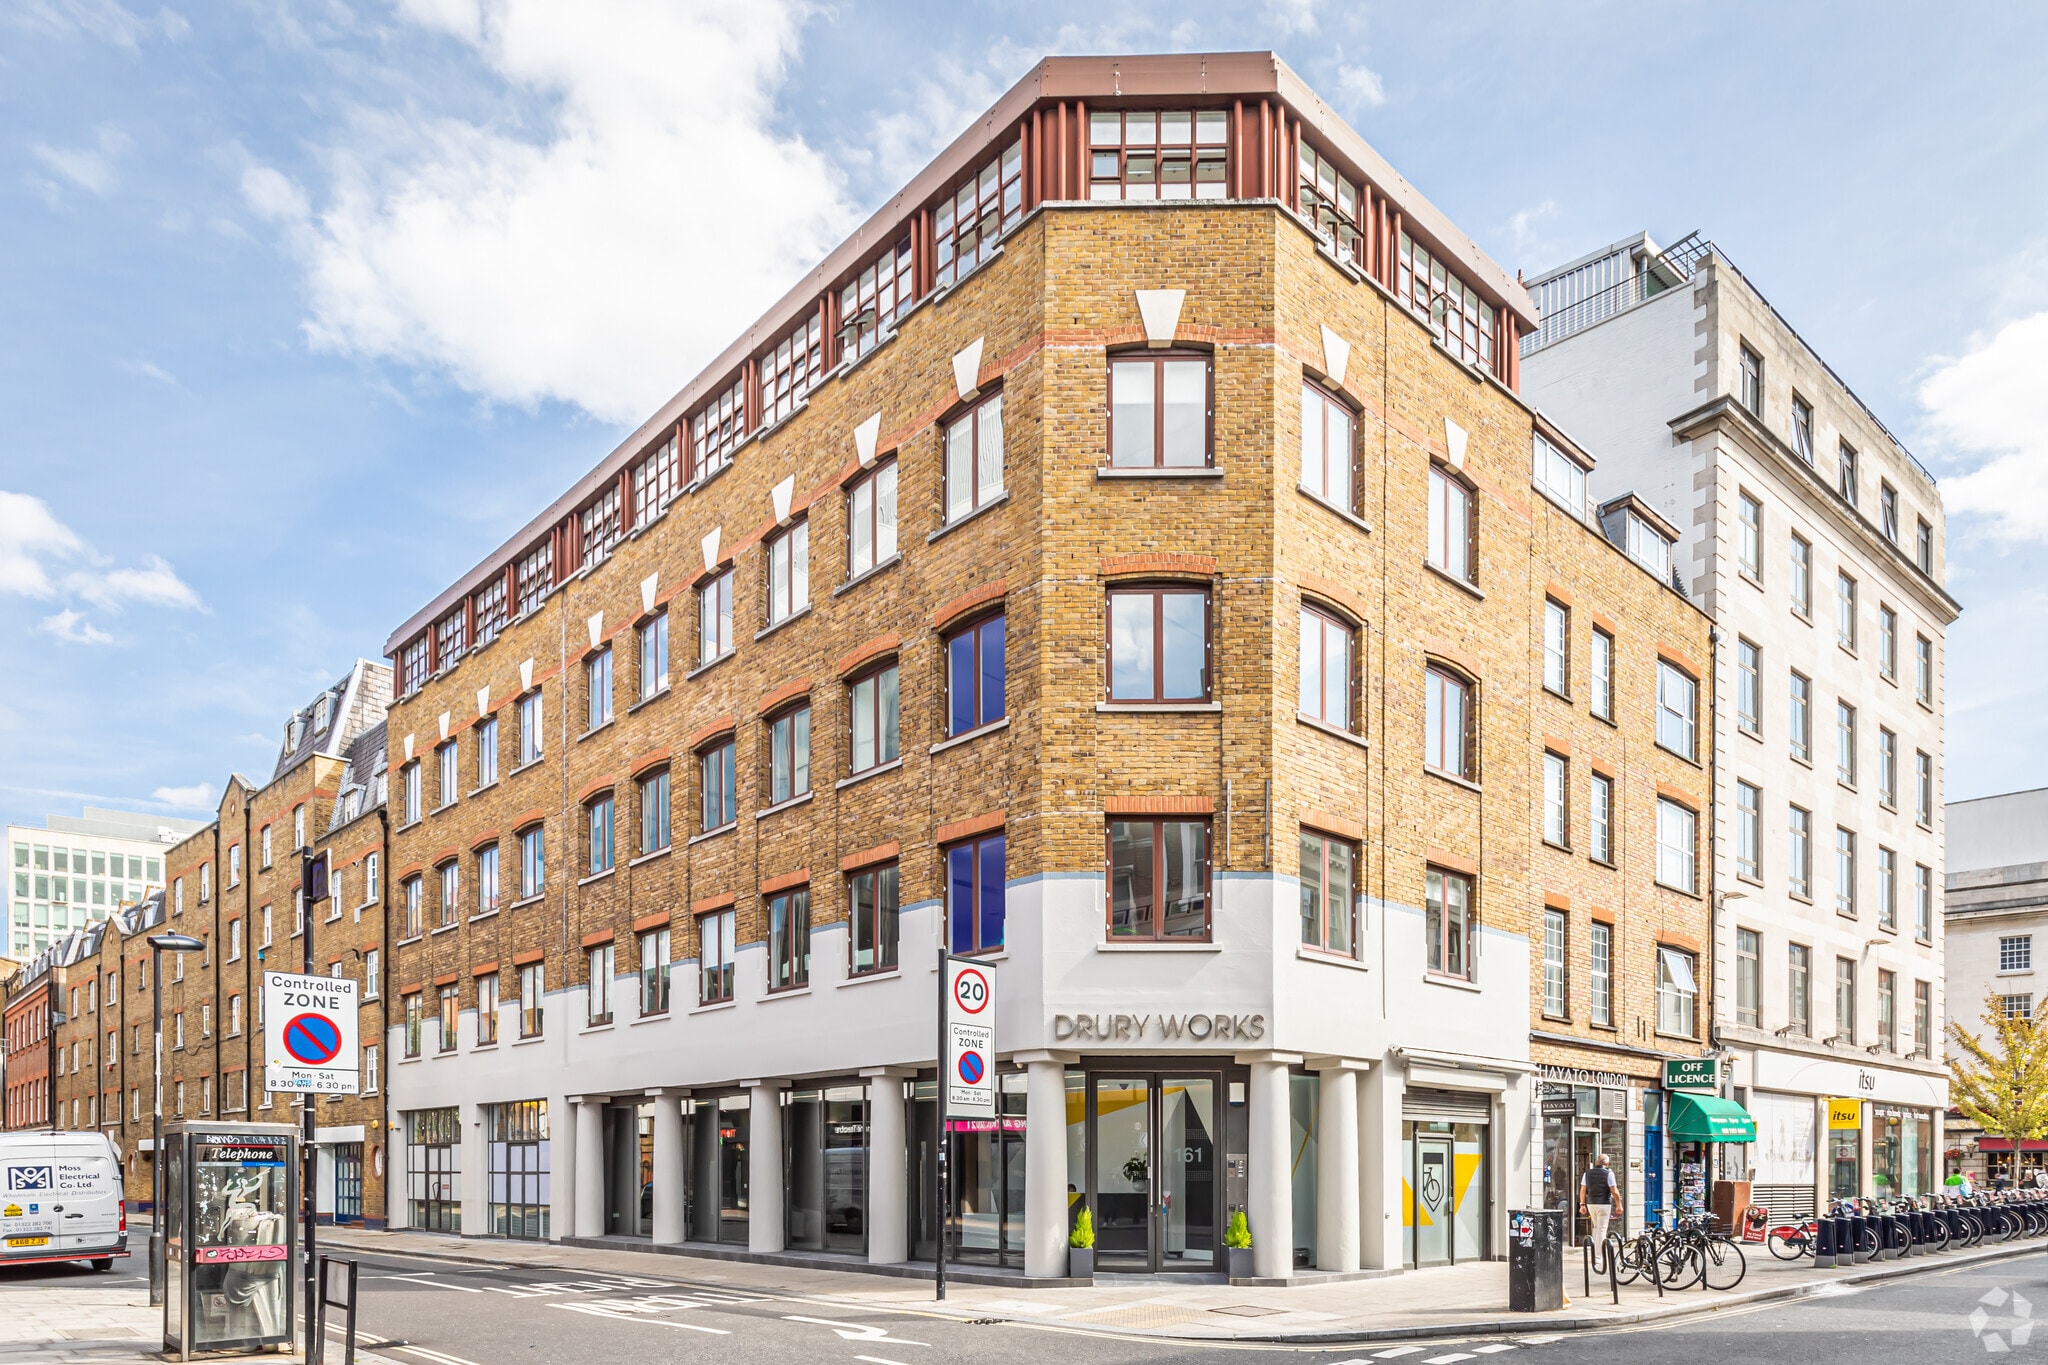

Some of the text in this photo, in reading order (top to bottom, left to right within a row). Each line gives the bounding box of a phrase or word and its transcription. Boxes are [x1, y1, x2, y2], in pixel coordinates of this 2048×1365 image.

[272, 976, 351, 993] Controlled
[960, 981, 984, 1001] 20
[284, 992, 340, 1009] ZONE
[953, 1027, 989, 1038] Controlled
[1055, 1013, 1265, 1039] DRURY WORKS
[959, 1037, 984, 1049] ZONE
[1681, 1062, 1703, 1072] OFF
[1539, 1064, 1629, 1087] HAYATO LONDON
[1668, 1074, 1715, 1083] LICENCE
[1858, 1069, 1875, 1090] itsu
[270, 1080, 294, 1088] 8.30
[316, 1081, 339, 1089] 6.30
[1832, 1111, 1855, 1121] itsu
[211, 1147, 273, 1160] Telephone
[1174, 1147, 1202, 1163] 161
